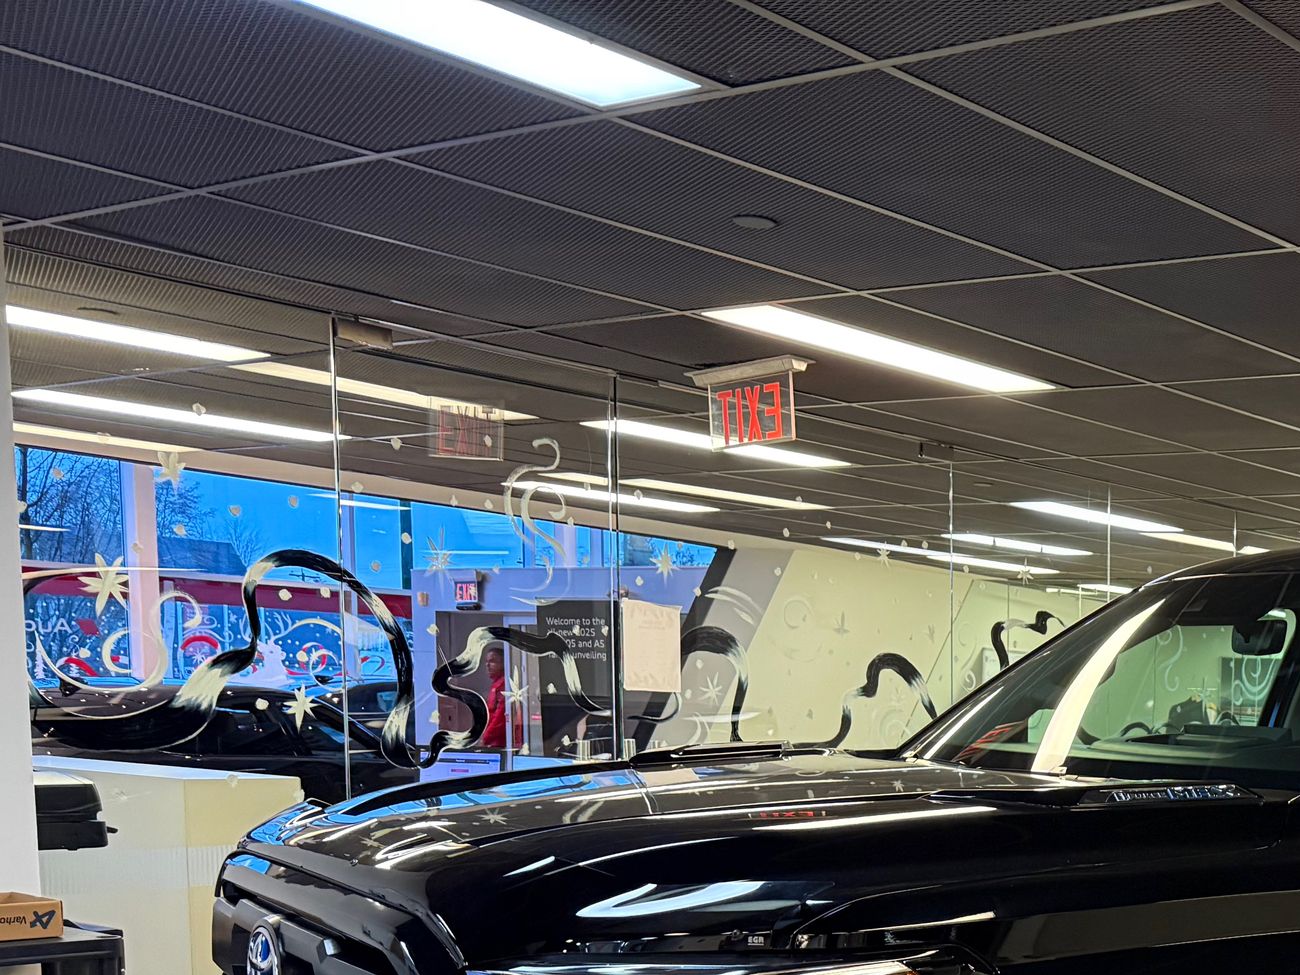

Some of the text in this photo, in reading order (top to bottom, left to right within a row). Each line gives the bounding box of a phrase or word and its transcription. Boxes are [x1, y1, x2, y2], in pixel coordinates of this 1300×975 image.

[438, 404, 496, 455] EXIT
[456, 583, 476, 601] EXIT
[546, 617, 580, 626] Welcome
[592, 617, 605, 625] the
[578, 639, 592, 648] and
[572, 651, 607, 661] unveiling
